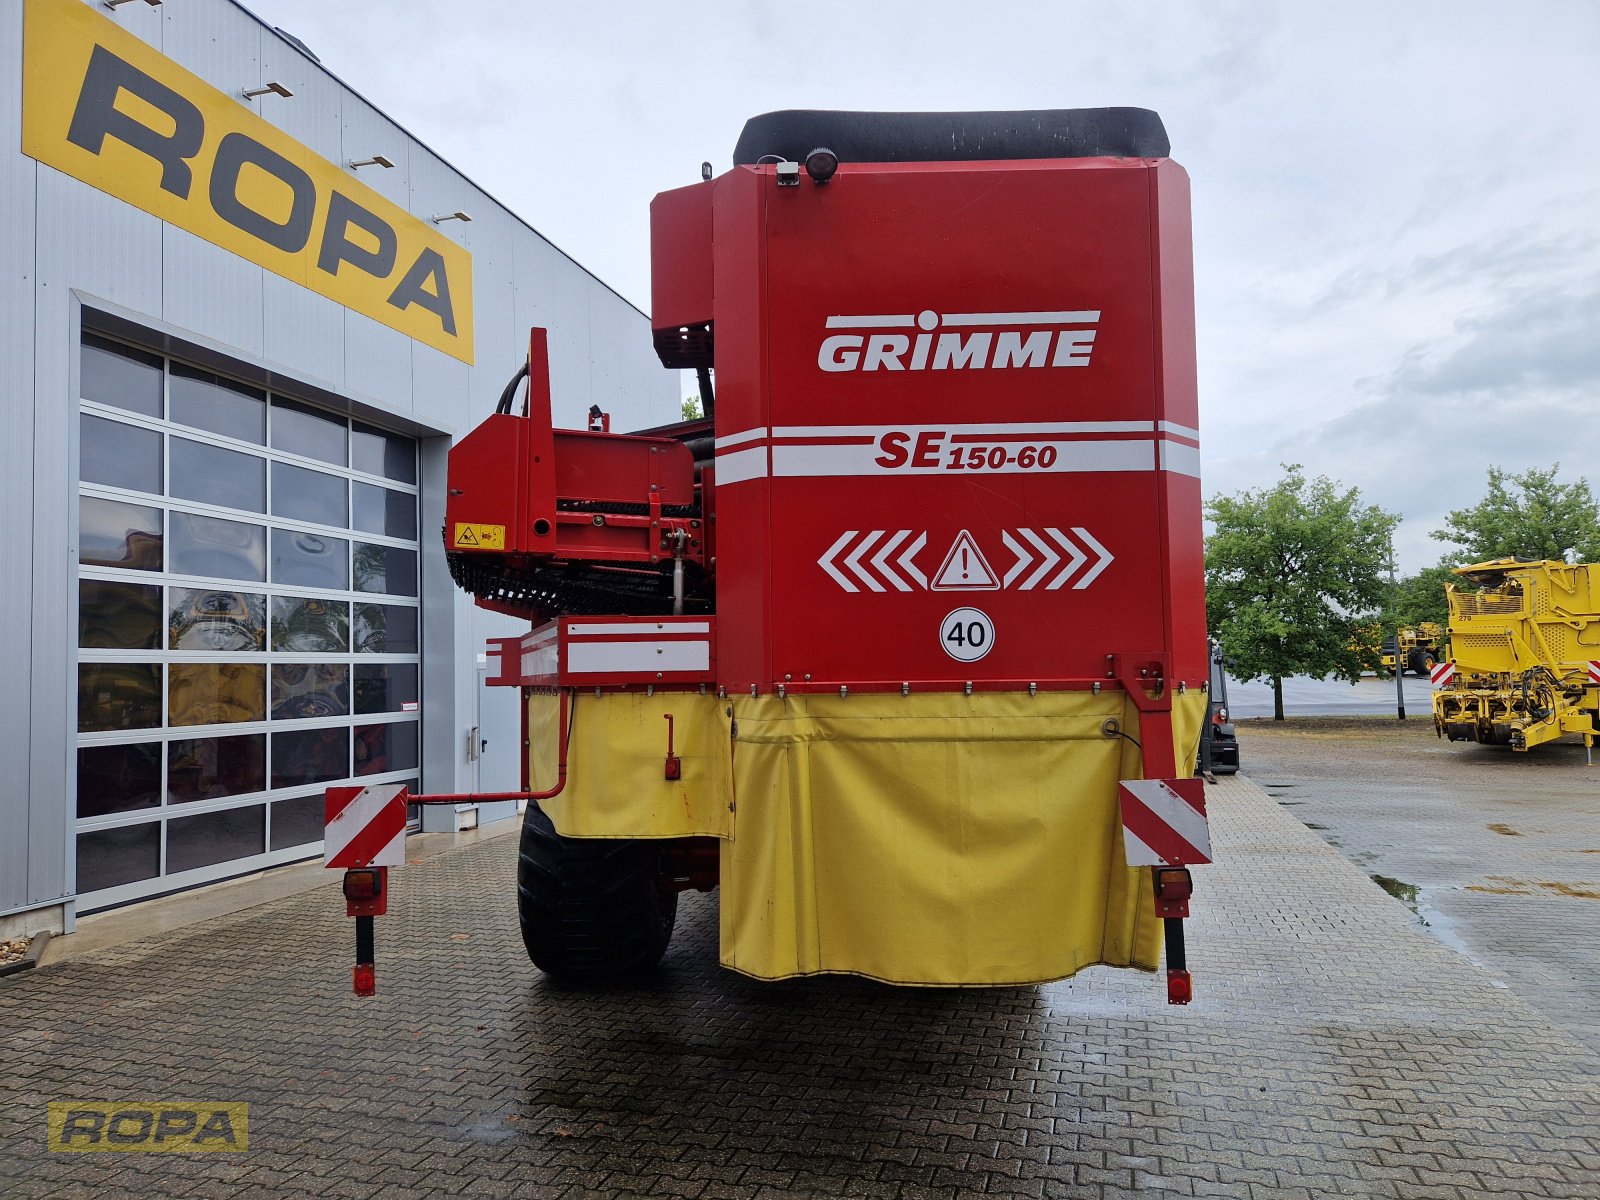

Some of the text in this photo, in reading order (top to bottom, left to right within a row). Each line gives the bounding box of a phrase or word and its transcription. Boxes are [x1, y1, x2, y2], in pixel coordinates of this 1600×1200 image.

[66, 42, 457, 338] ROPA
[817, 309, 1097, 373] GRIMME
[874, 431, 1058, 470] SE 150-60
[946, 621, 986, 648] 40
